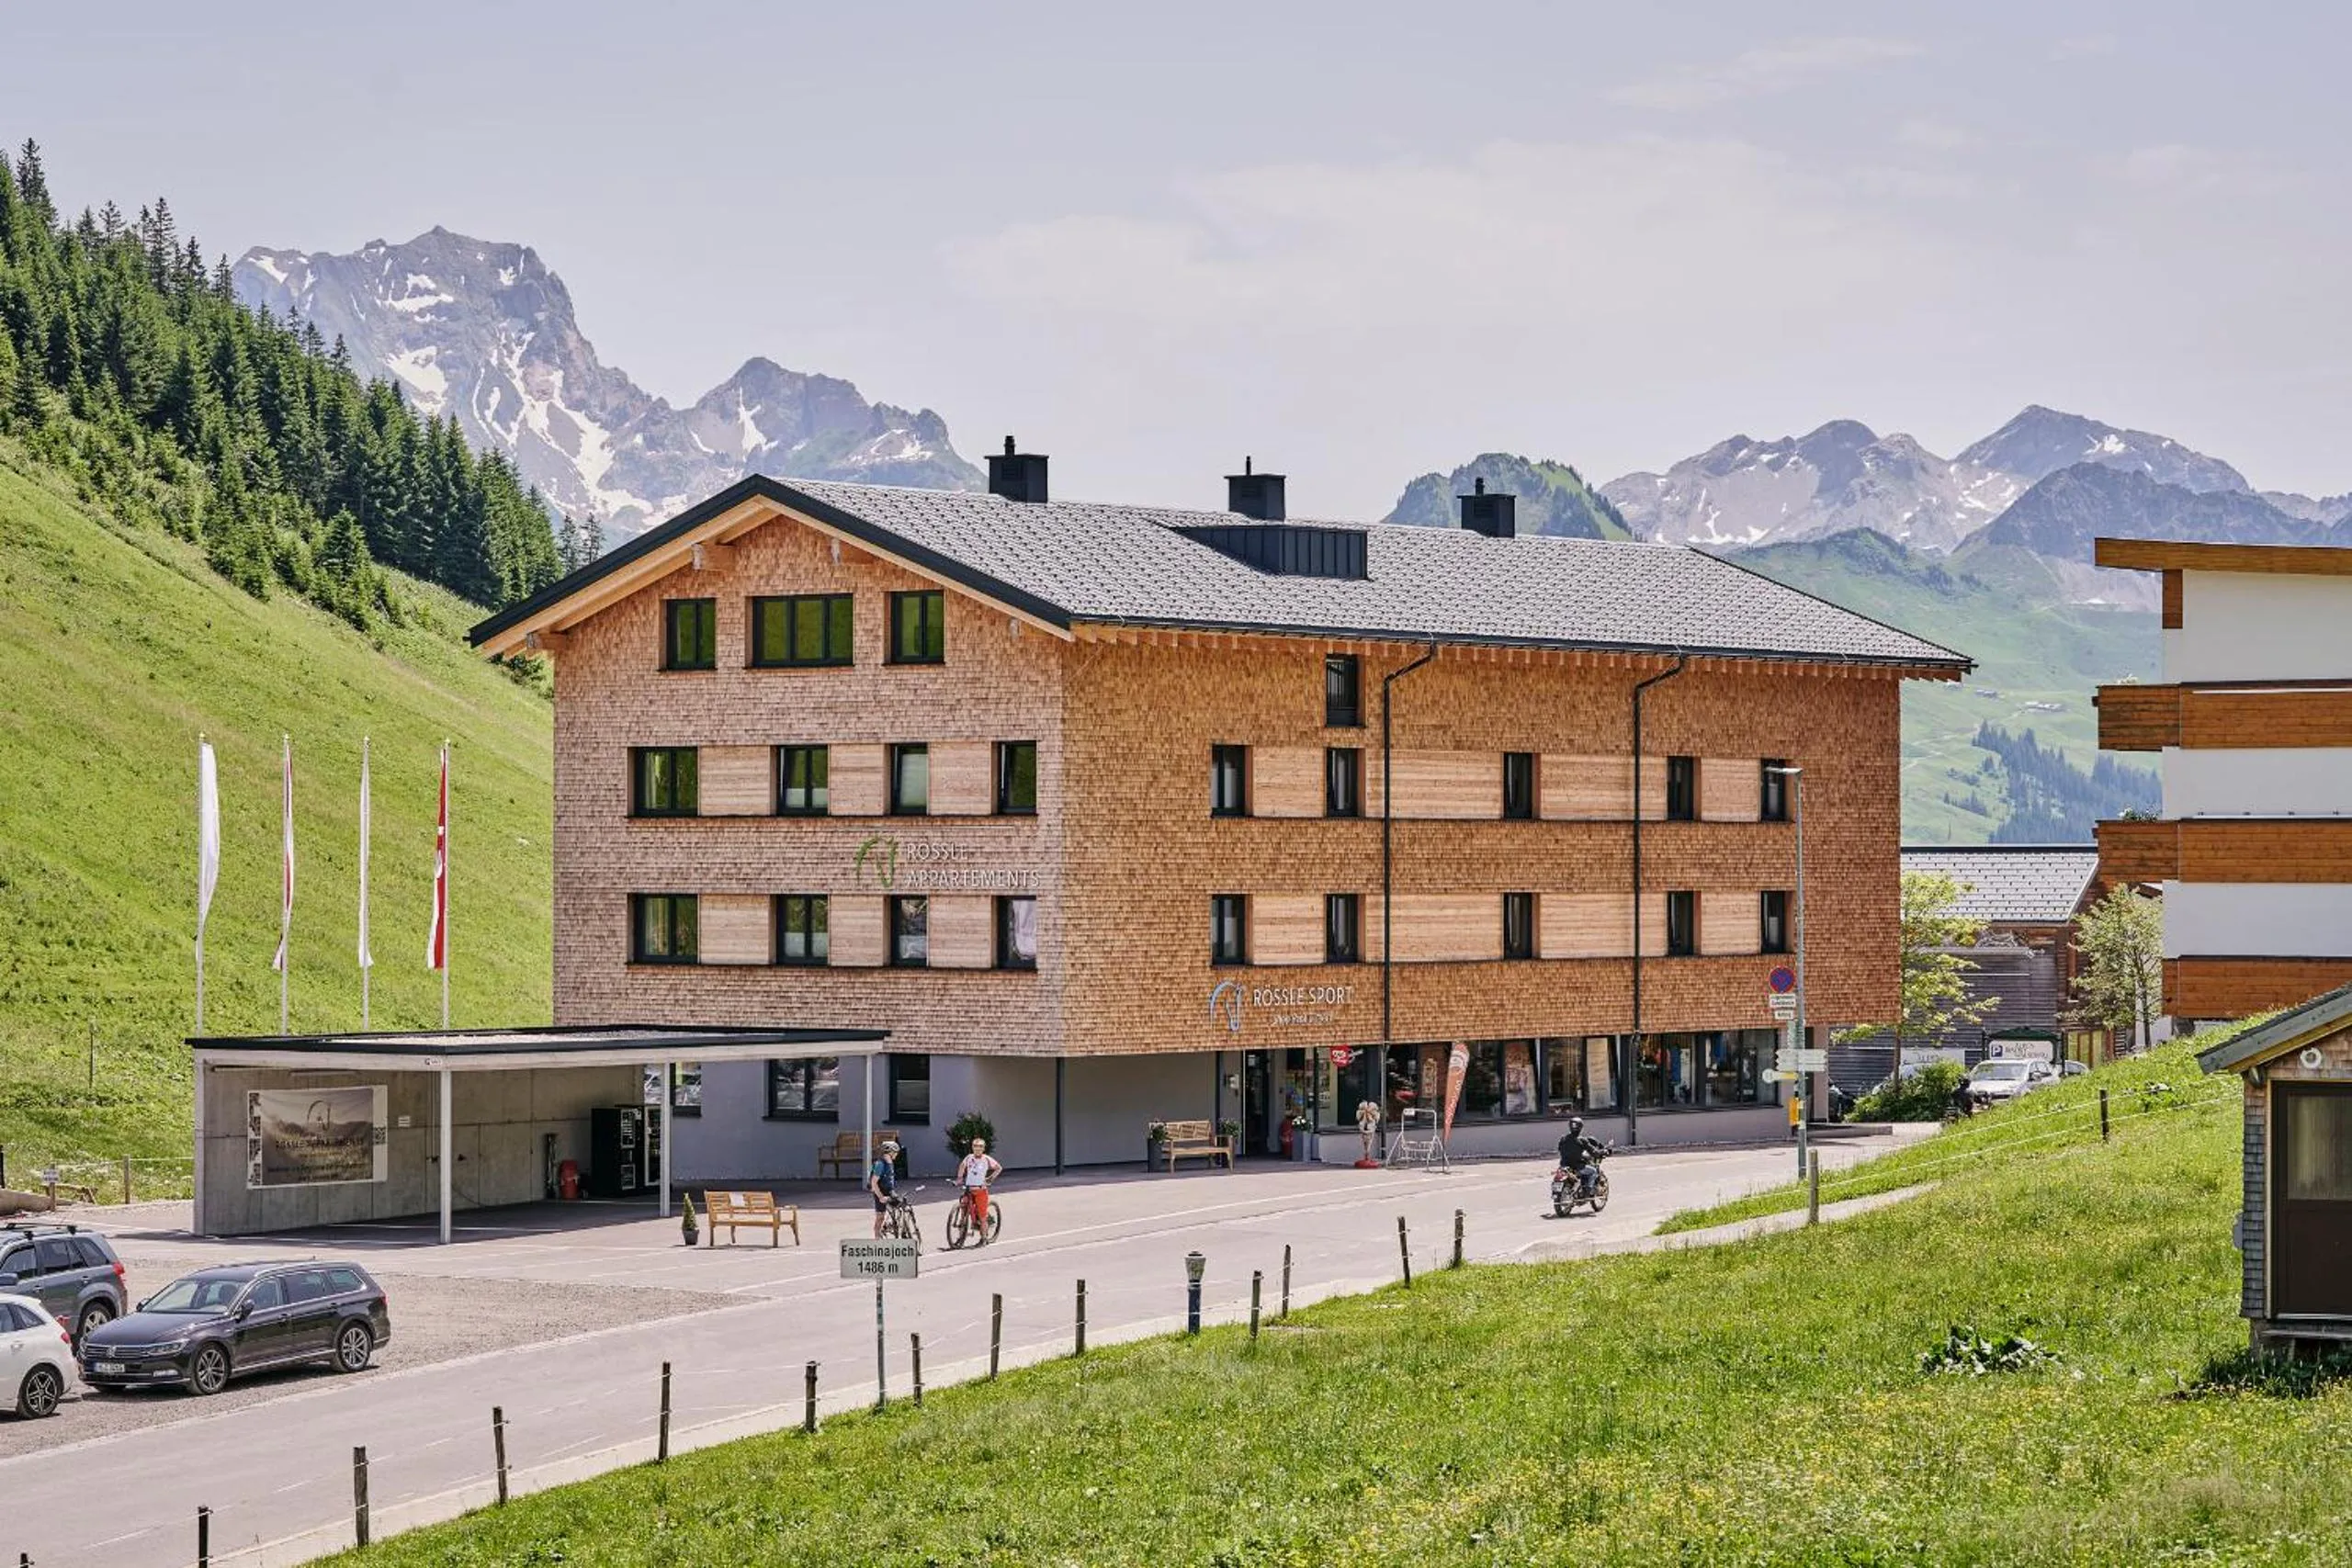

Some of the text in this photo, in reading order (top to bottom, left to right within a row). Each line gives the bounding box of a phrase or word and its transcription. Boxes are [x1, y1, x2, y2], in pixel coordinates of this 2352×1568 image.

[905, 869, 1041, 888] APPARTEMENTS
[1253, 985, 1352, 1007] RÖSSLE SPORT
[841, 1244, 915, 1259] Faschinajoch
[857, 1261, 899, 1274] 1486 m
